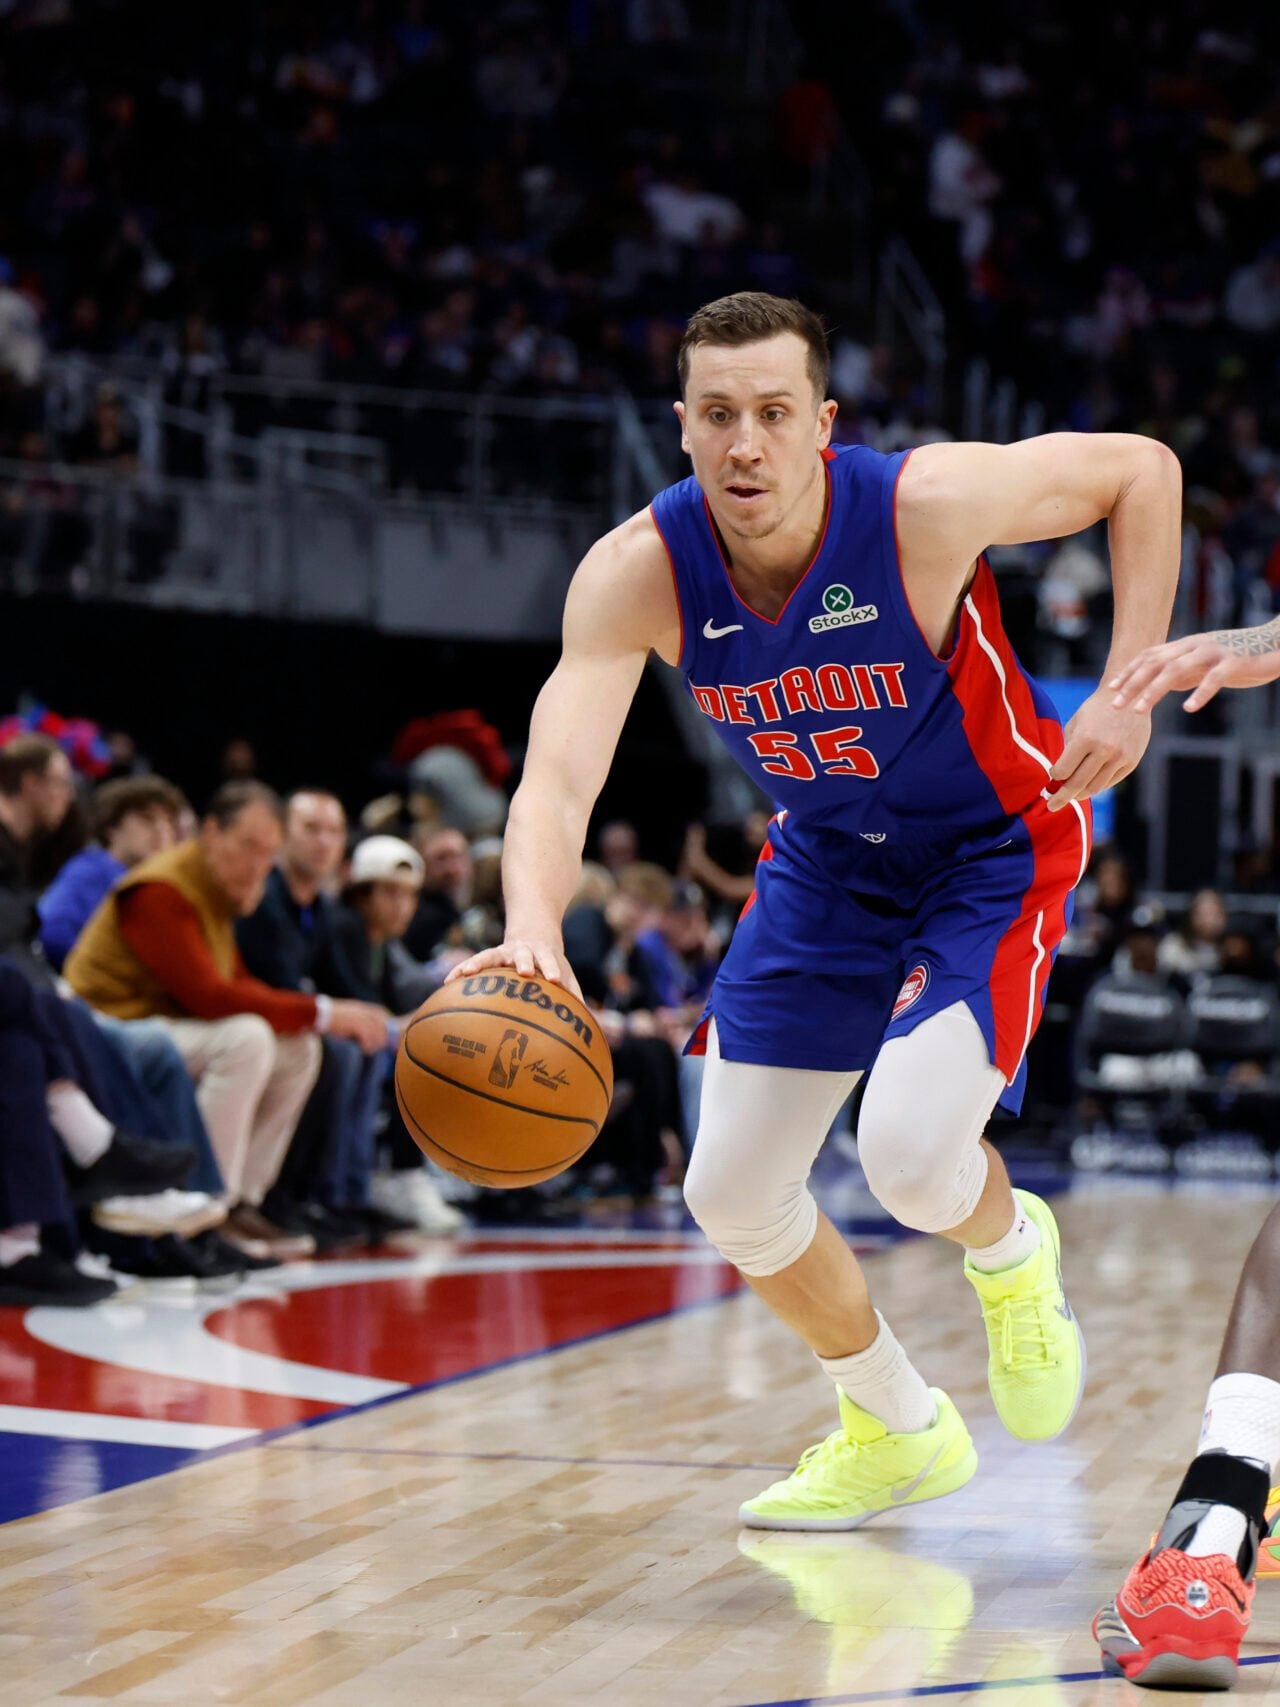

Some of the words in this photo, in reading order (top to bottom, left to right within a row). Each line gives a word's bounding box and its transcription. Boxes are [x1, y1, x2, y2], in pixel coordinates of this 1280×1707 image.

[811, 606, 876, 630] StockX
[688, 662, 908, 726] DETROIT
[747, 726, 880, 781] 55
[462, 976, 593, 1048] Wilson
